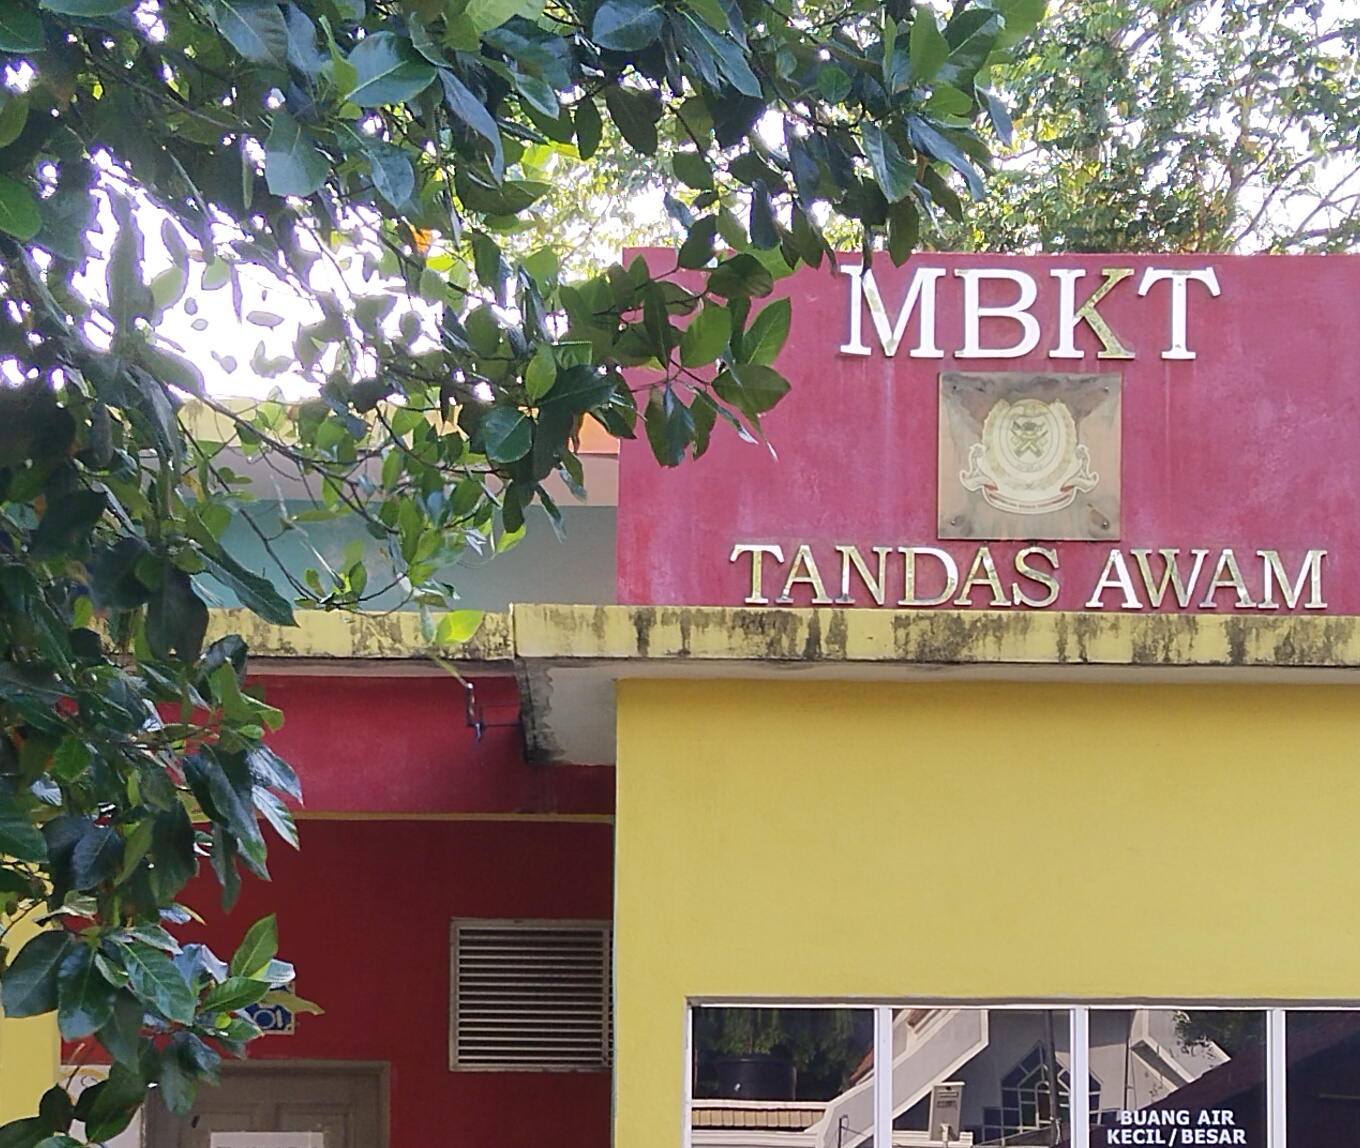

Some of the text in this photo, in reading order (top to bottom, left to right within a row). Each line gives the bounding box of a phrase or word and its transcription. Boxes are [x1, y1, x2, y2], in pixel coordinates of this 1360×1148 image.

[839, 265, 1222, 361] MBKT
[730, 544, 1329, 610] TANDAS AWAM
[1120, 1110, 1236, 1126] BUANG AIR
